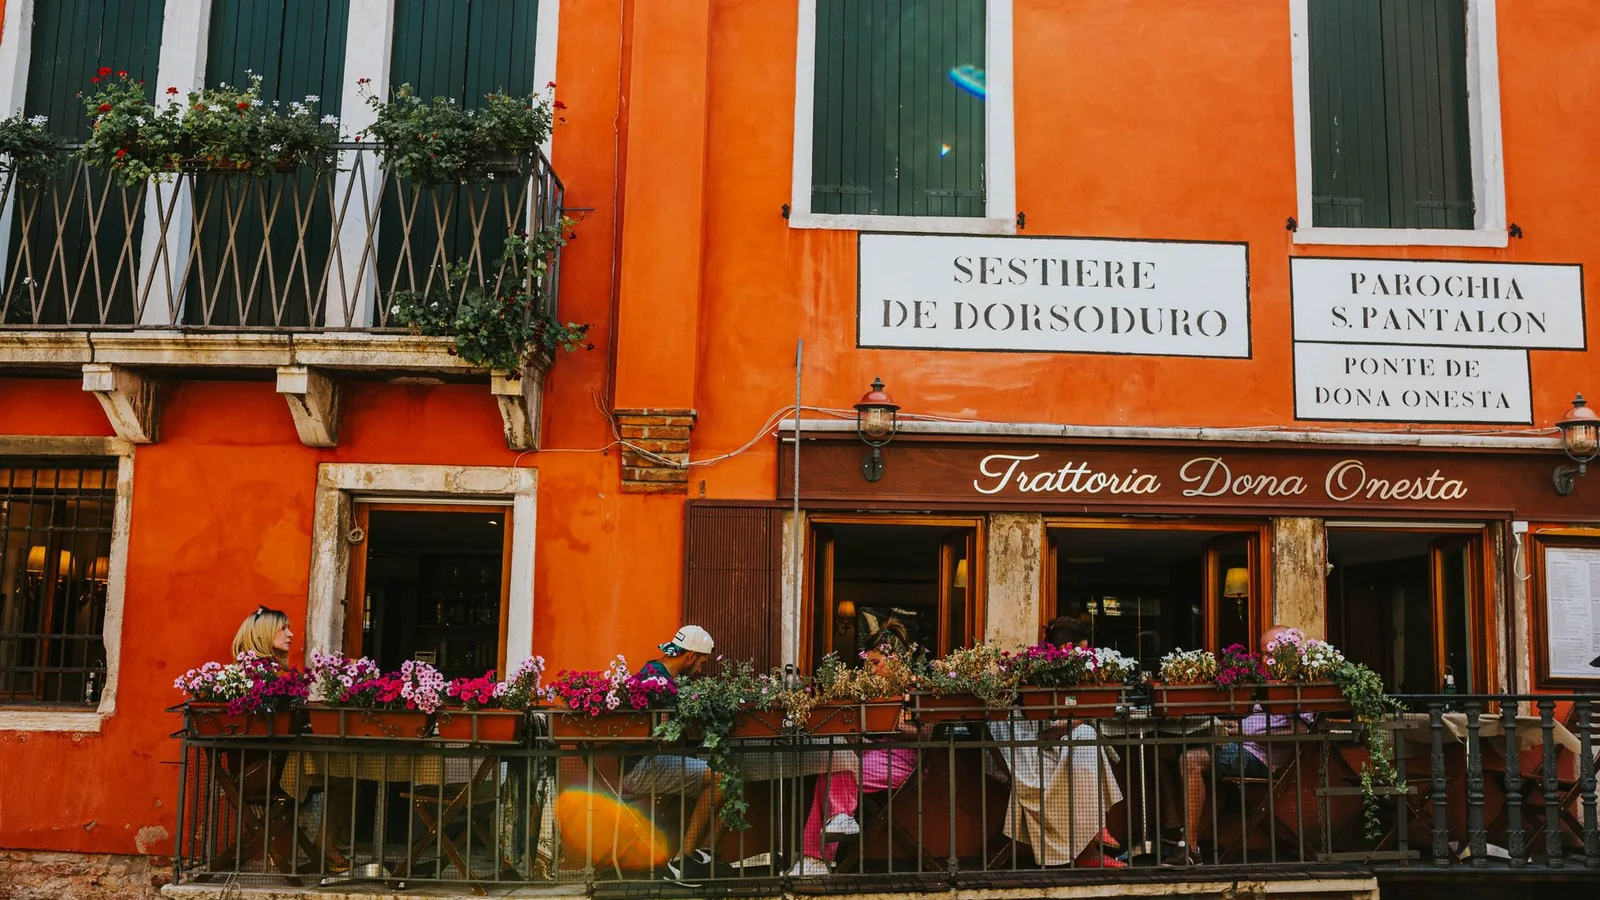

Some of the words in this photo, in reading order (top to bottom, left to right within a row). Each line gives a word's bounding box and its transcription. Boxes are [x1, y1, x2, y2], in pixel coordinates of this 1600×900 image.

[953, 256, 1156, 289] SESTIERE
[1350, 272, 1525, 300] PAROCHIA
[881, 299, 938, 329] DE
[953, 301, 1228, 338] DORSODURO
[1344, 357, 1435, 377] PONTE
[1446, 359, 1480, 378] DE
[1315, 386, 1391, 408] DONA
[1402, 389, 1511, 409] ONESTA
[973, 453, 1161, 495] Trattoria
[1179, 457, 1307, 498] Dona
[1325, 461, 1467, 501] Onesta
